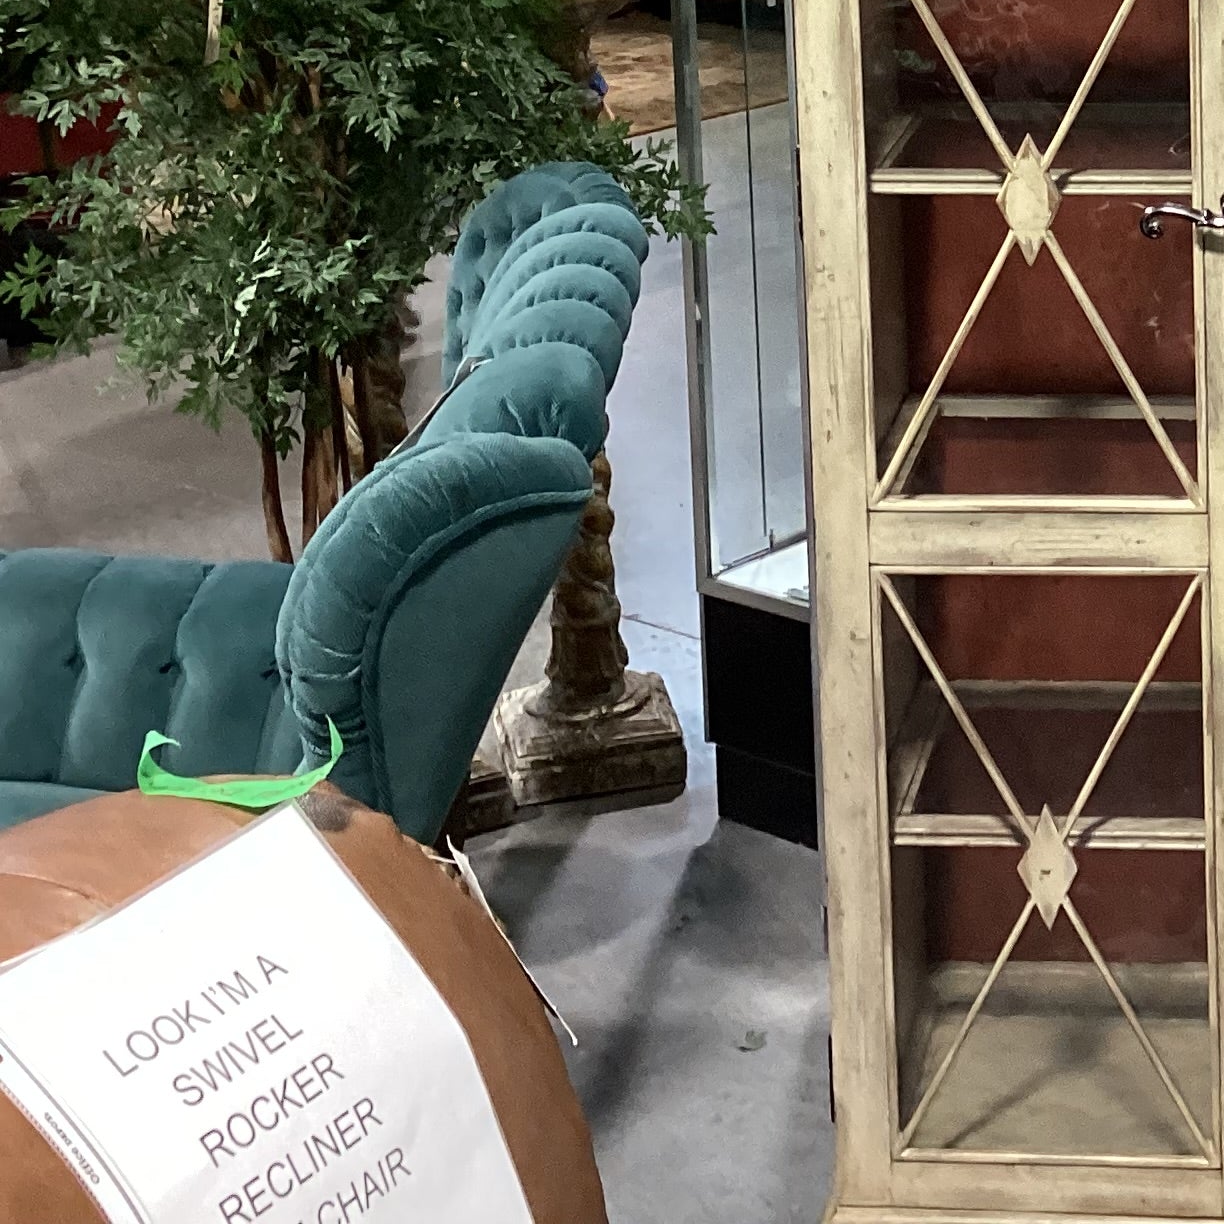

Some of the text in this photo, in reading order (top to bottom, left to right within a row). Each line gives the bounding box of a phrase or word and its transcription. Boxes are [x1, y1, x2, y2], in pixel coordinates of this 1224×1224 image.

[102, 999, 211, 1077] LOOK
[256, 955, 289, 985] A
[172, 1014, 304, 1106] SWIVEL
[199, 1052, 345, 1168] ROCKER
[218, 1097, 383, 1224] RECLINER
